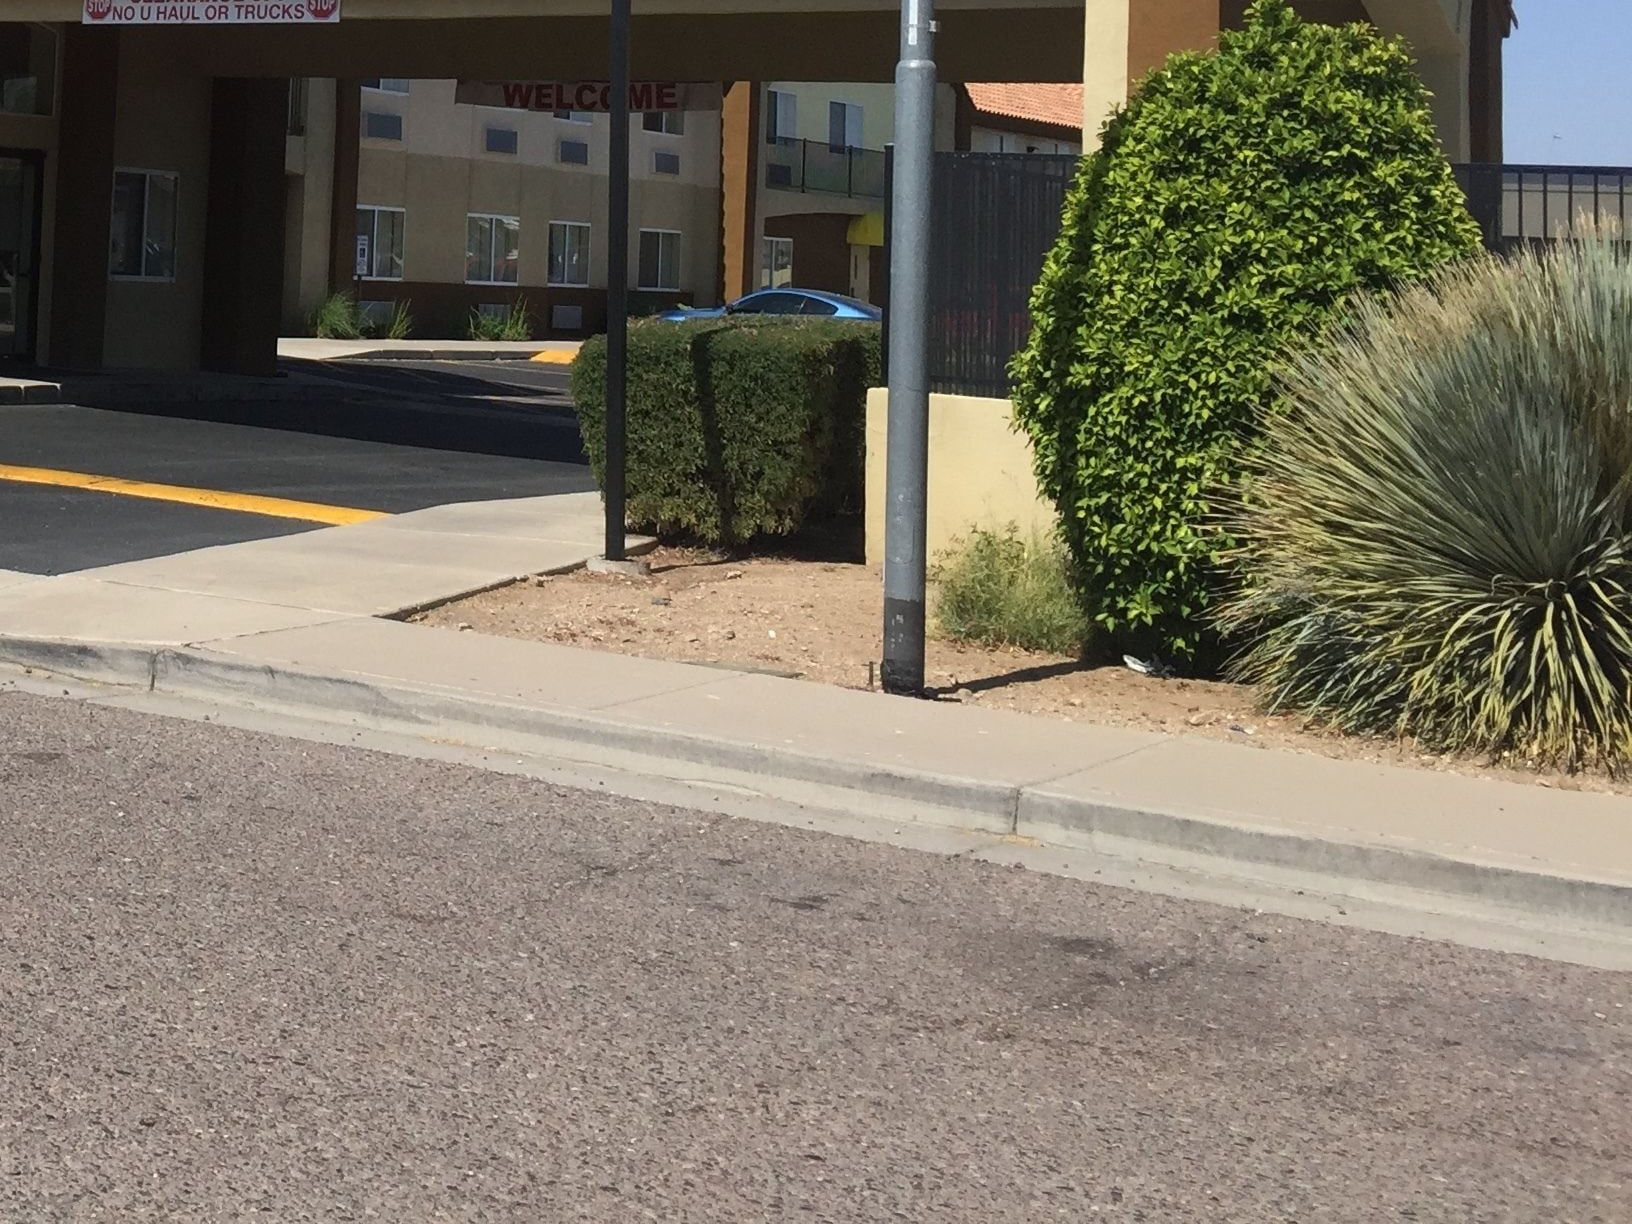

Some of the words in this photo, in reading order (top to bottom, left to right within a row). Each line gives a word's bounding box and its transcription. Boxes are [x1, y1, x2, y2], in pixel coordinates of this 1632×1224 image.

[112, 5, 135, 21] NO
[140, 5, 151, 21] U
[156, 5, 200, 21] HAUL
[204, 4, 229, 21] OR
[234, 4, 305, 20] TRUCKS
